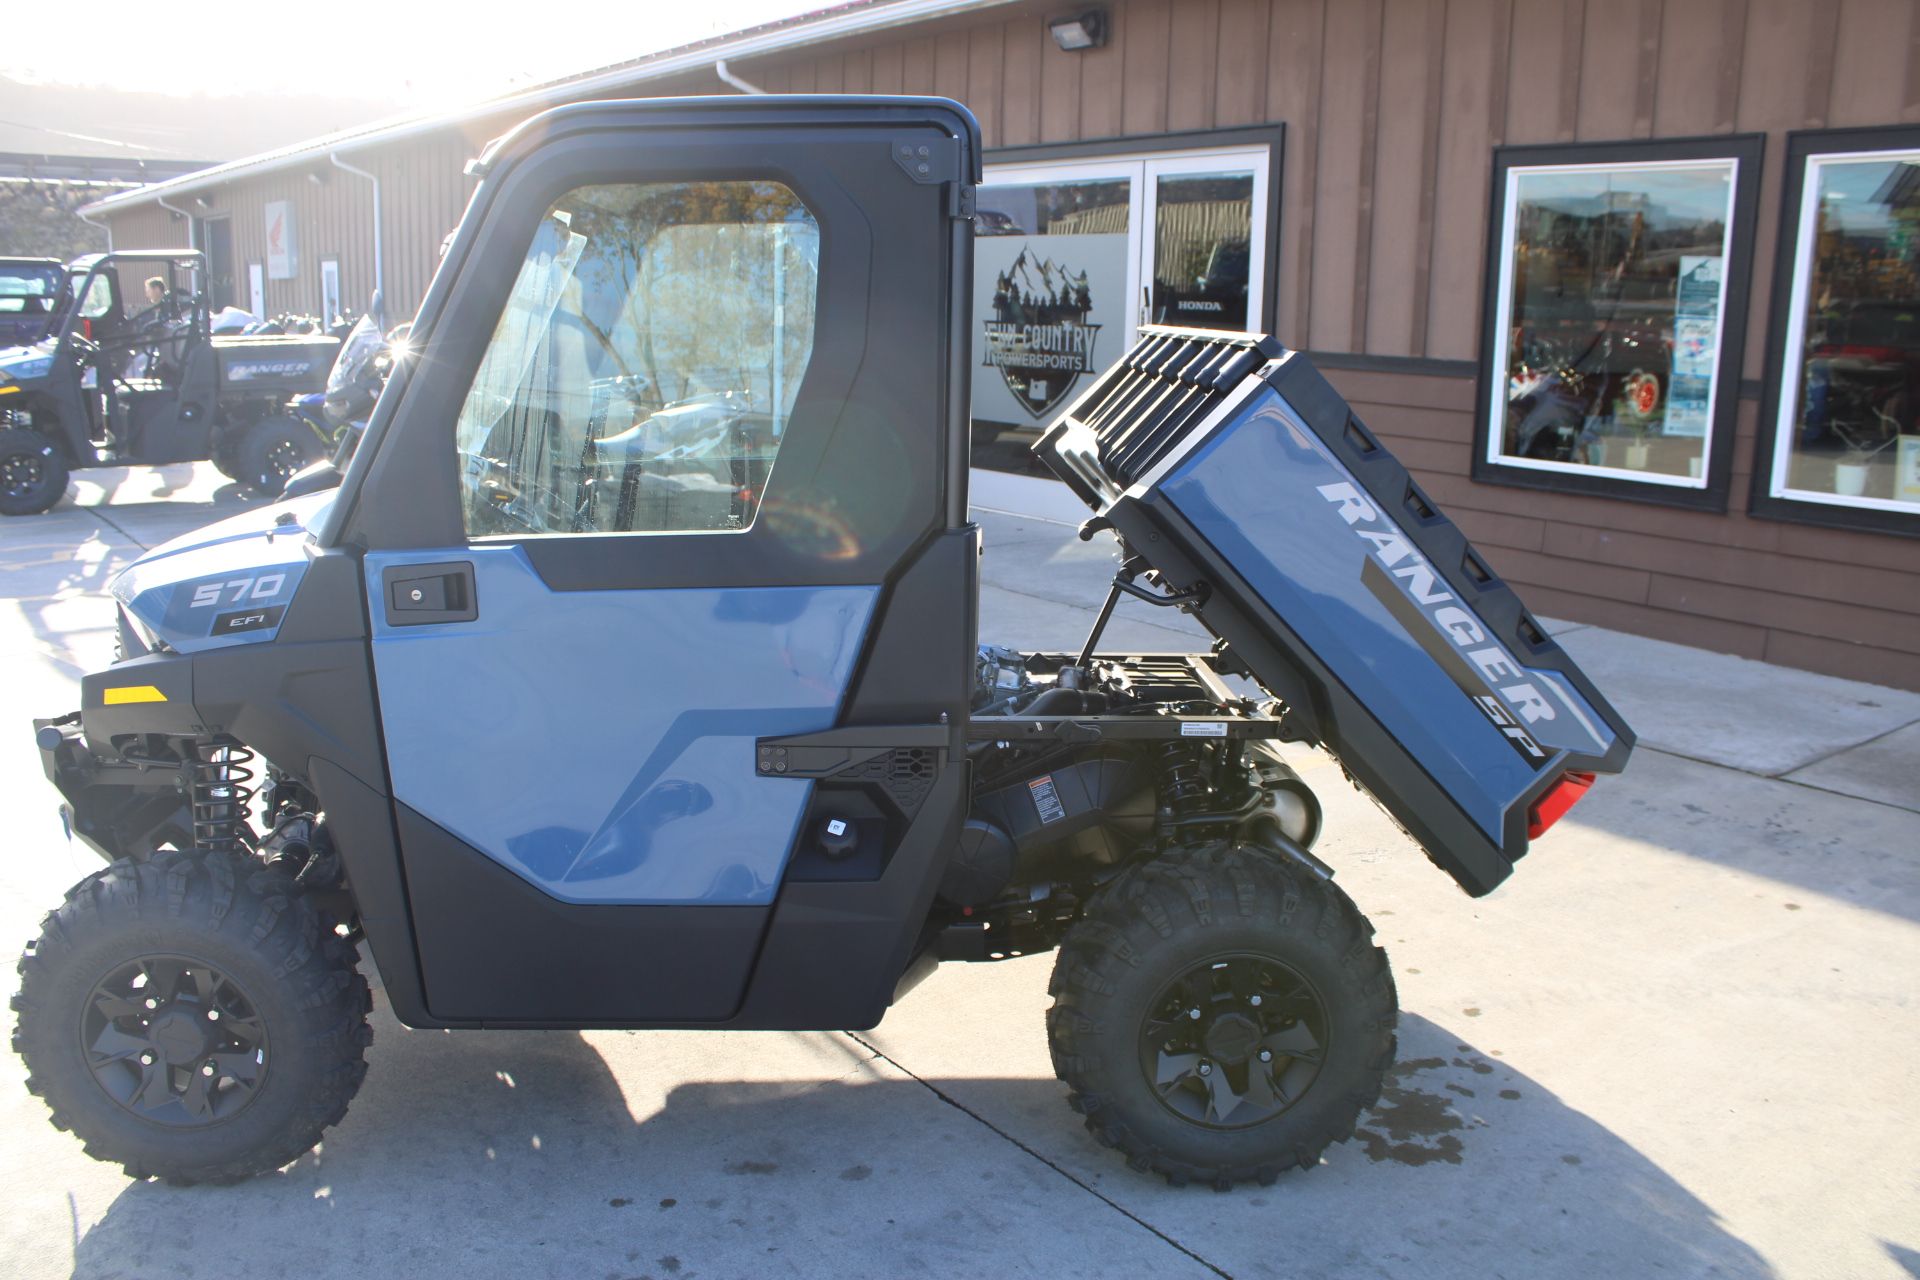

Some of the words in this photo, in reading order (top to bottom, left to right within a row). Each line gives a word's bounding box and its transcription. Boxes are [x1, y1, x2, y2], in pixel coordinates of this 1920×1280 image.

[1178, 300, 1222, 311] HONDA
[984, 322, 1016, 366] FUN
[1022, 321, 1098, 371] COUNTRY
[998, 351, 1083, 370] POWERSPORTS
[191, 574, 286, 607] 570
[1316, 481, 1555, 724] RANGER
[230, 614, 265, 627] EFI
[1473, 696, 1545, 757] SP
